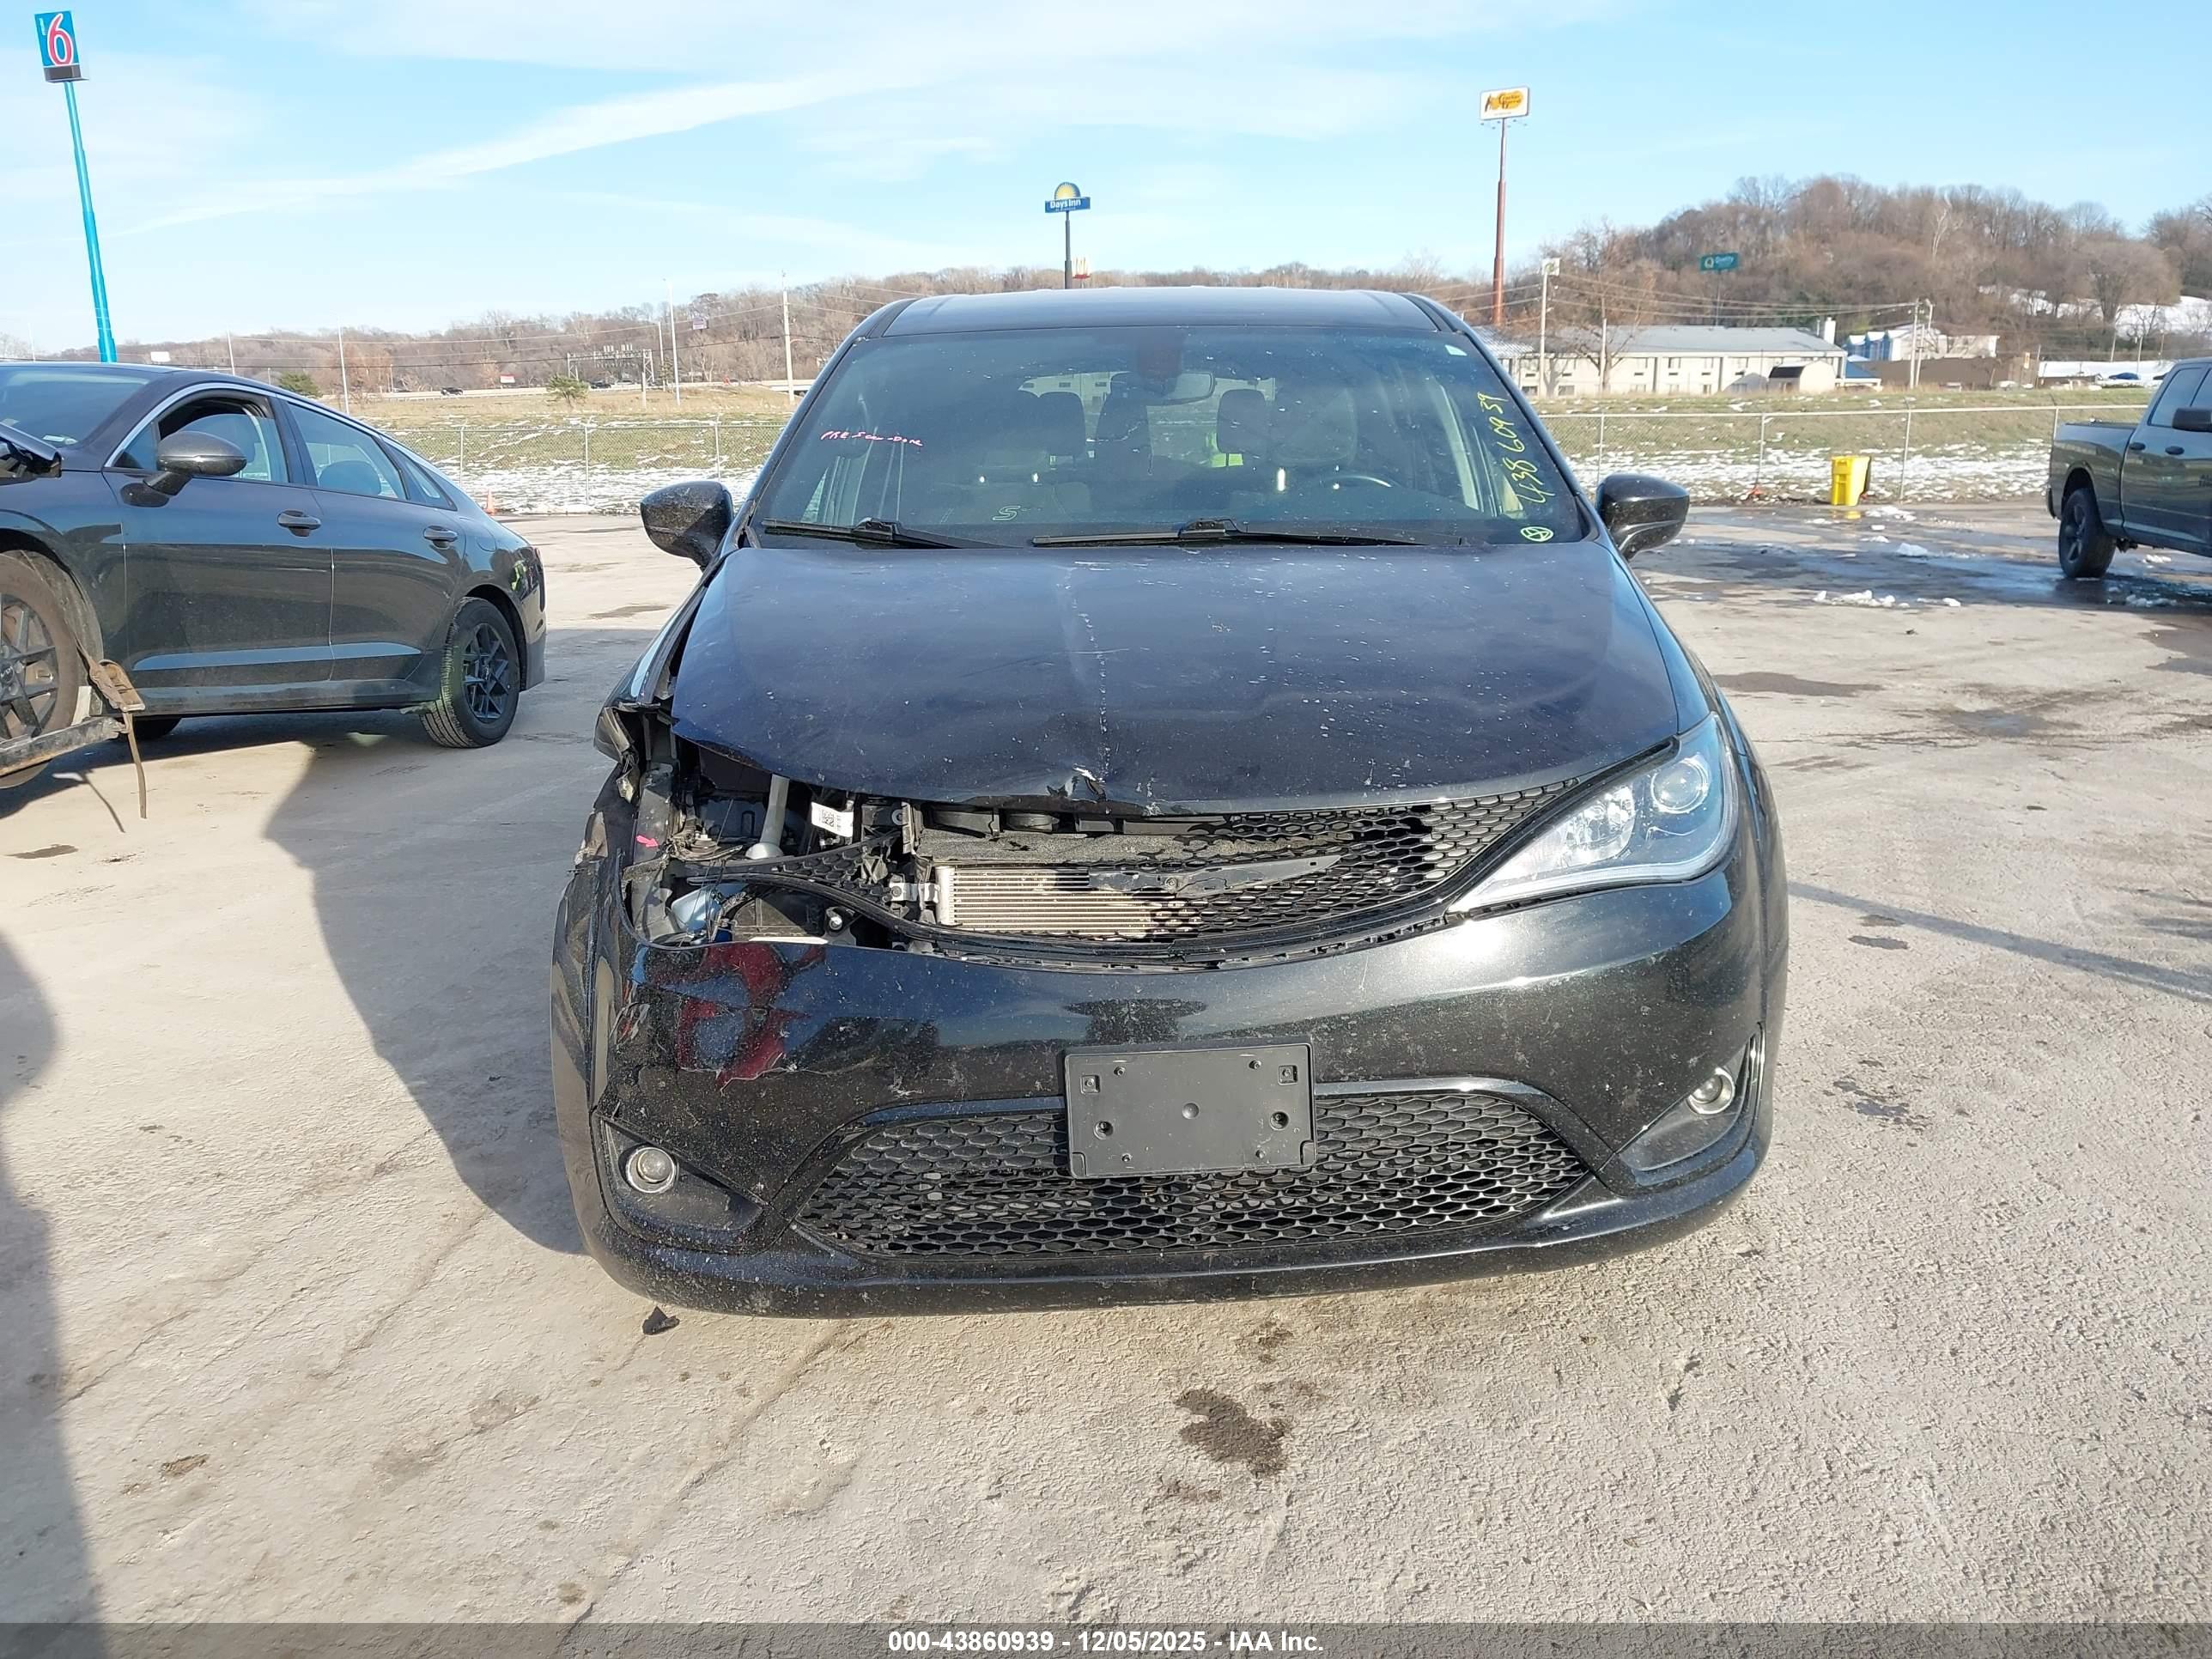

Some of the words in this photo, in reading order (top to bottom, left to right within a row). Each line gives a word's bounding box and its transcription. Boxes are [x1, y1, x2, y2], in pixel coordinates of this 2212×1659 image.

[47, 13, 74, 66] 6
[1050, 200, 1068, 210] Days
[1068, 198, 1082, 207] Inn
